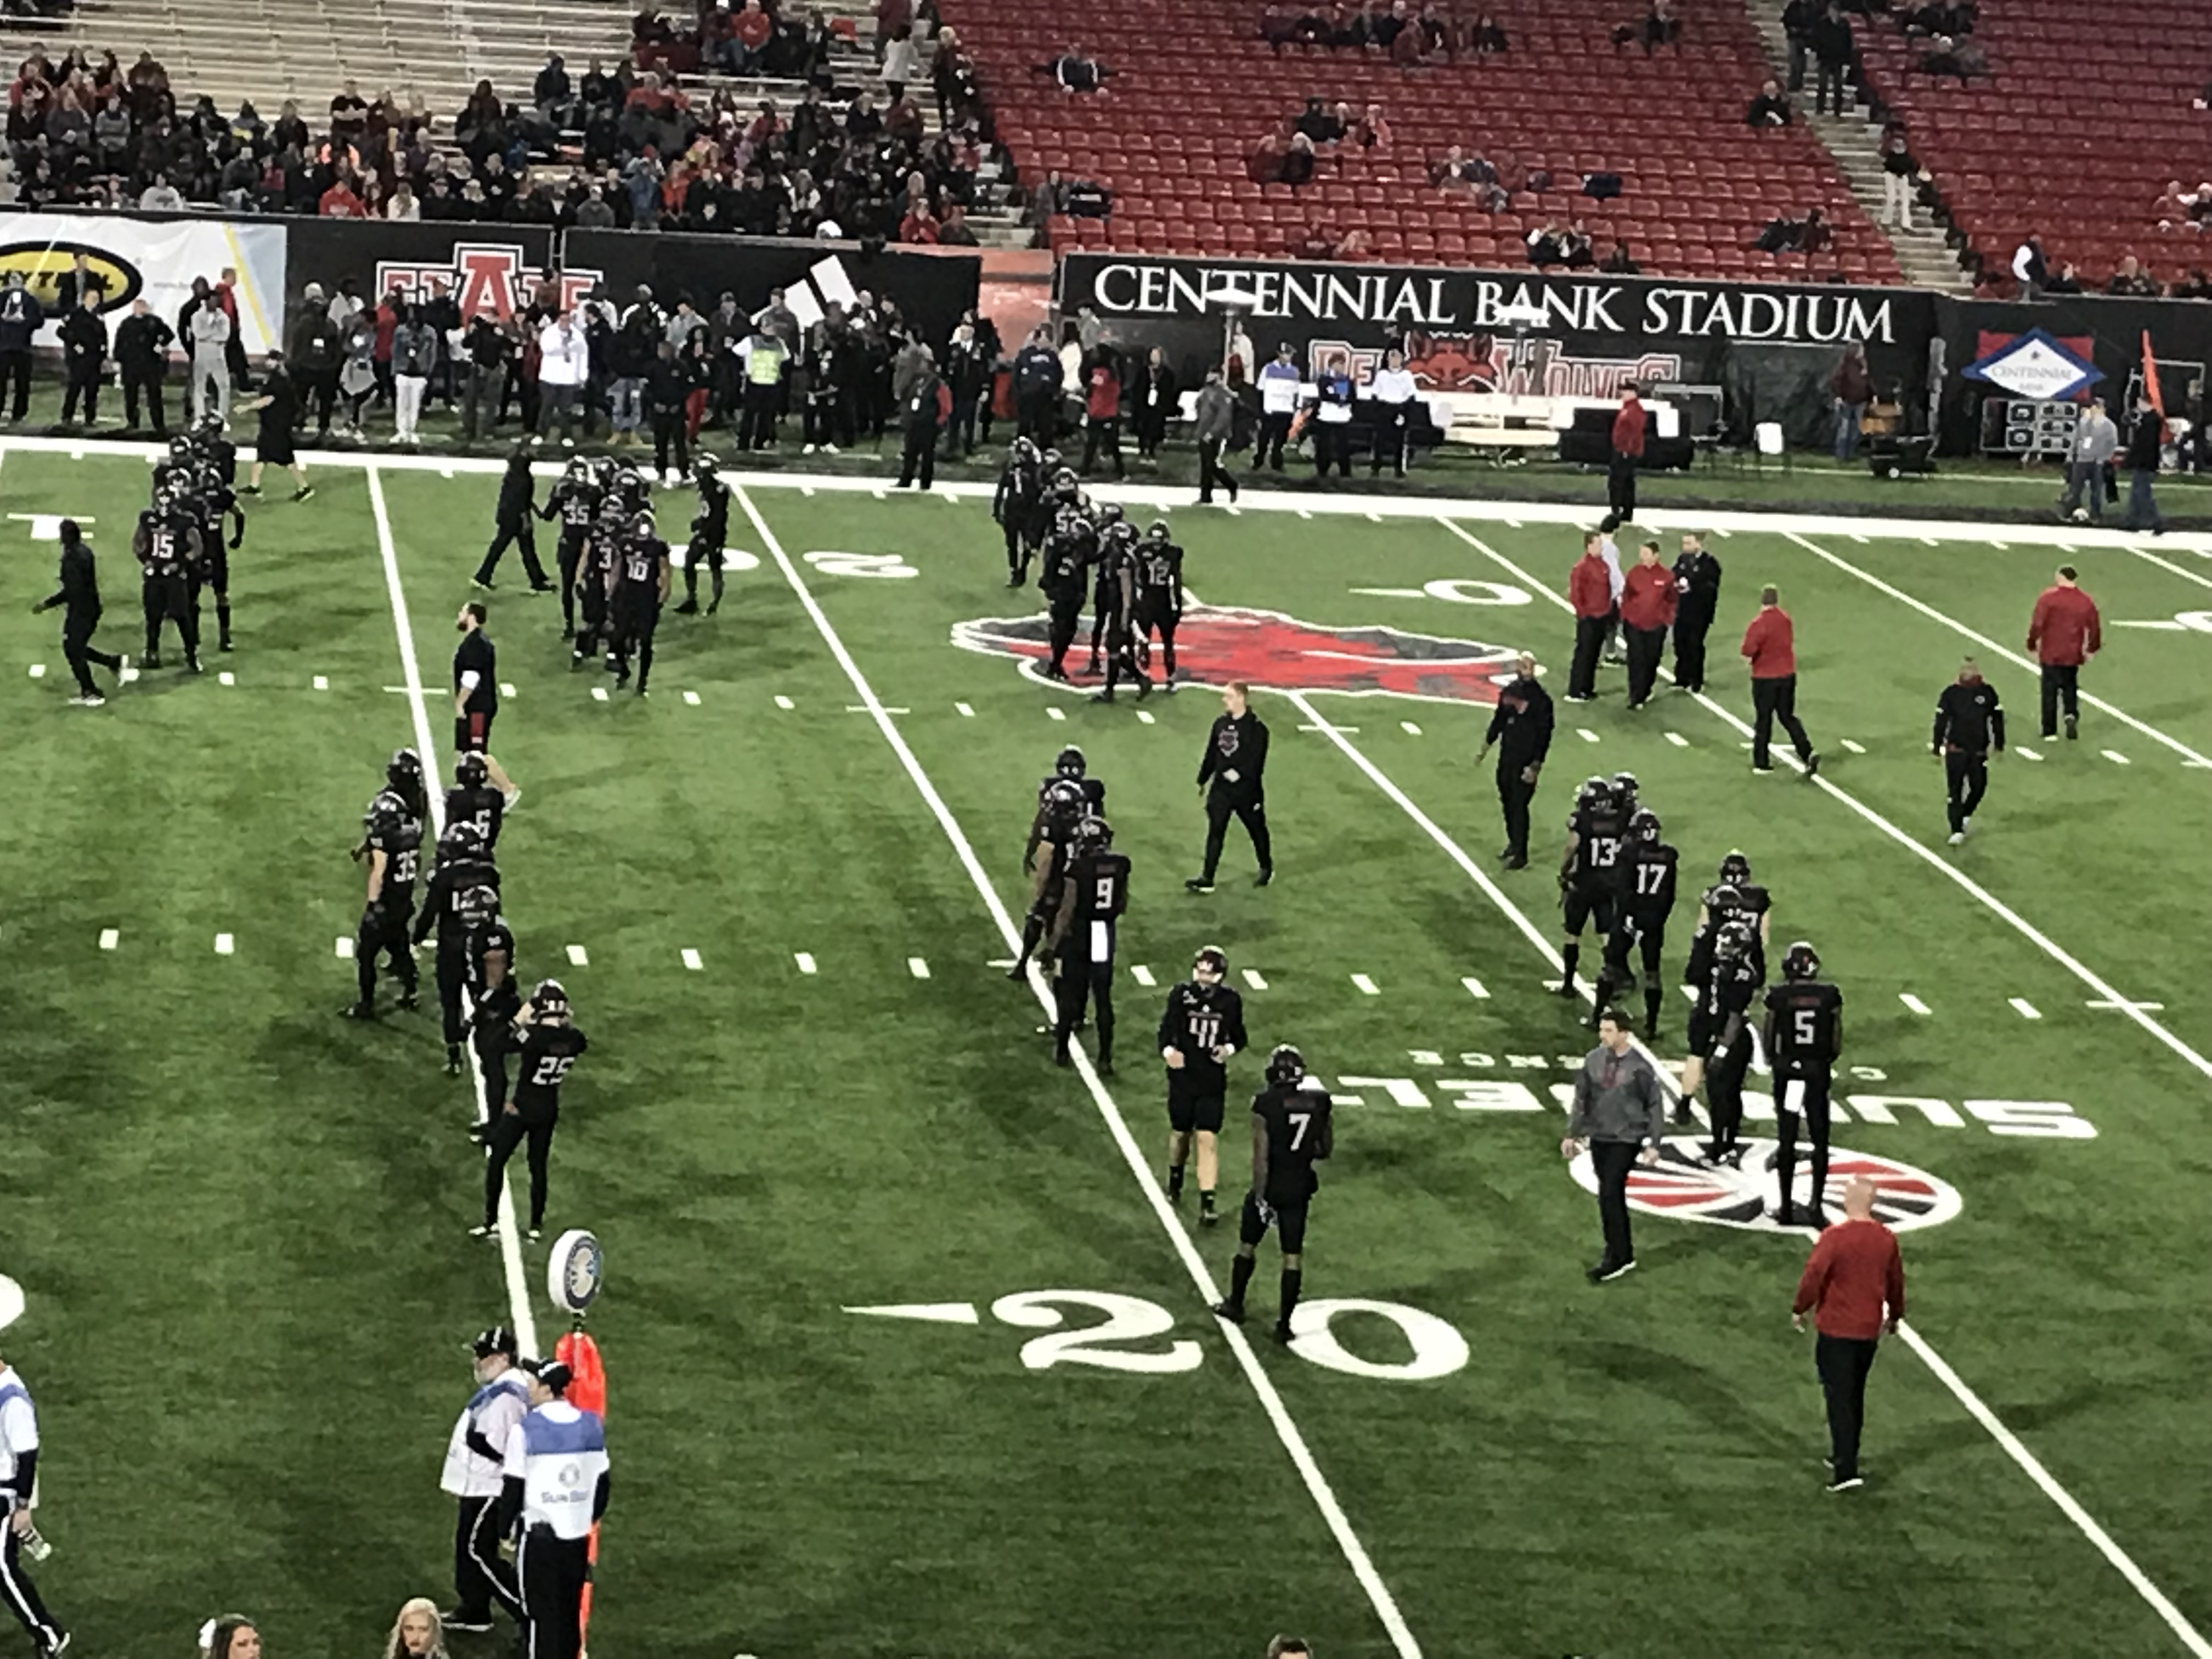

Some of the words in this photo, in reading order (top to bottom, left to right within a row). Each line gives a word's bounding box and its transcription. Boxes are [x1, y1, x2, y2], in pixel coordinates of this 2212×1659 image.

[1094, 264, 1455, 324] CENTENNIAL
[1474, 281, 1626, 332] BANK
[1643, 289, 1896, 343] STADIUM
[151, 533, 174, 558] 15
[1590, 826, 1617, 866] 13
[1095, 877, 1114, 910] 9
[1637, 864, 1667, 894] 17
[1189, 1017, 1219, 1048] 41
[1795, 1010, 1816, 1044] 5
[1289, 1113, 1311, 1152] 7
